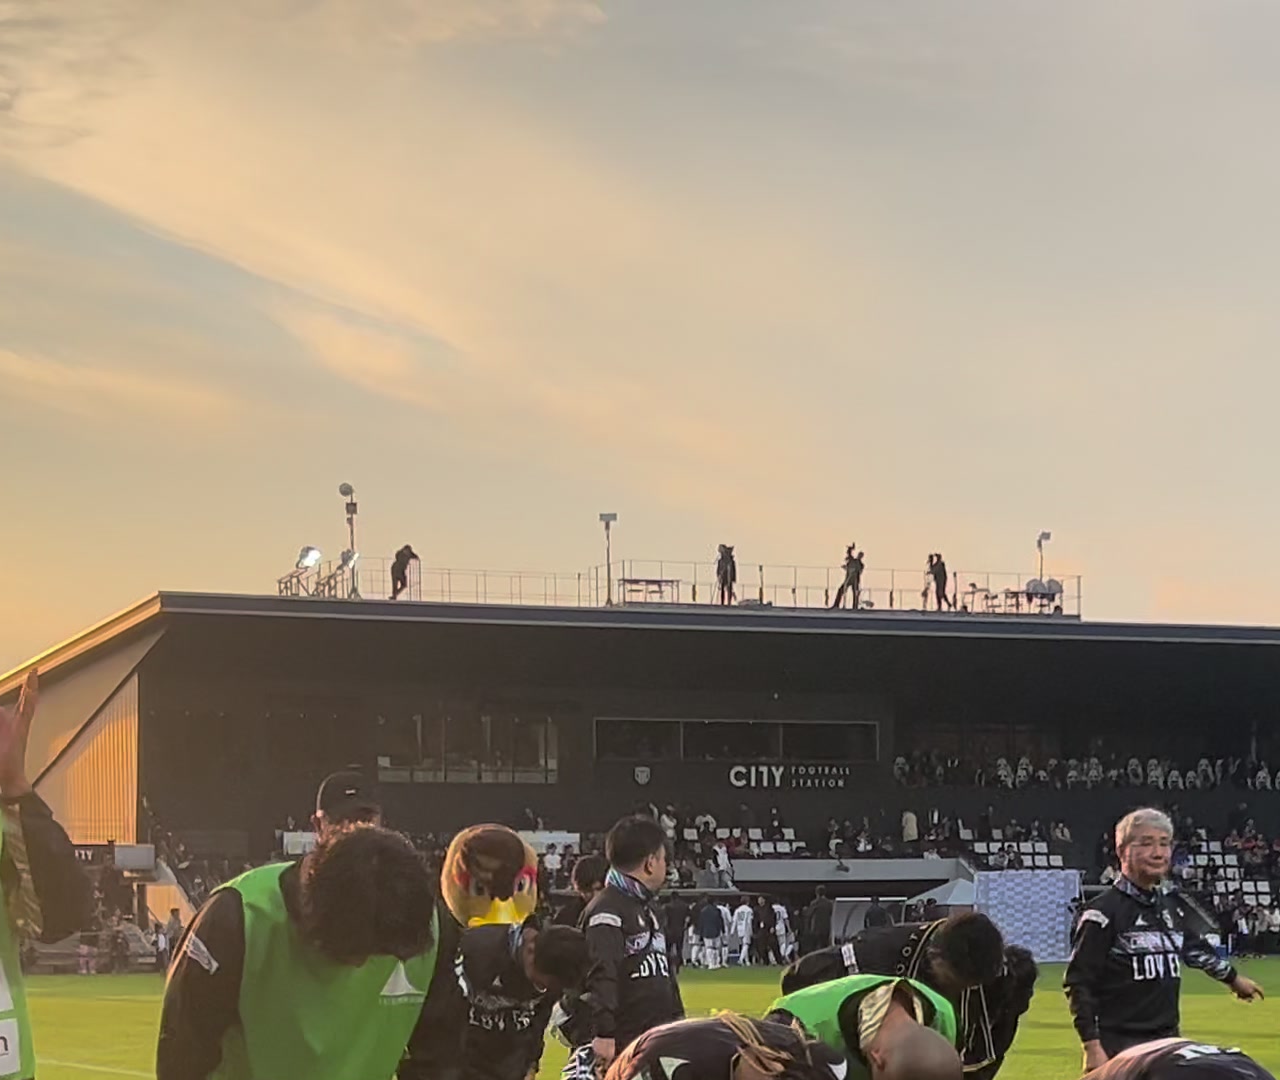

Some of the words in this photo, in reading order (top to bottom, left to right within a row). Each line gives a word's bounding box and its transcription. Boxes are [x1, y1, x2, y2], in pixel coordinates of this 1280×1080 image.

[729, 765, 784, 788] CITY
[791, 765, 850, 775] FOOTBALL
[791, 779, 845, 788] STATION
[74, 848, 93, 861] ITY
